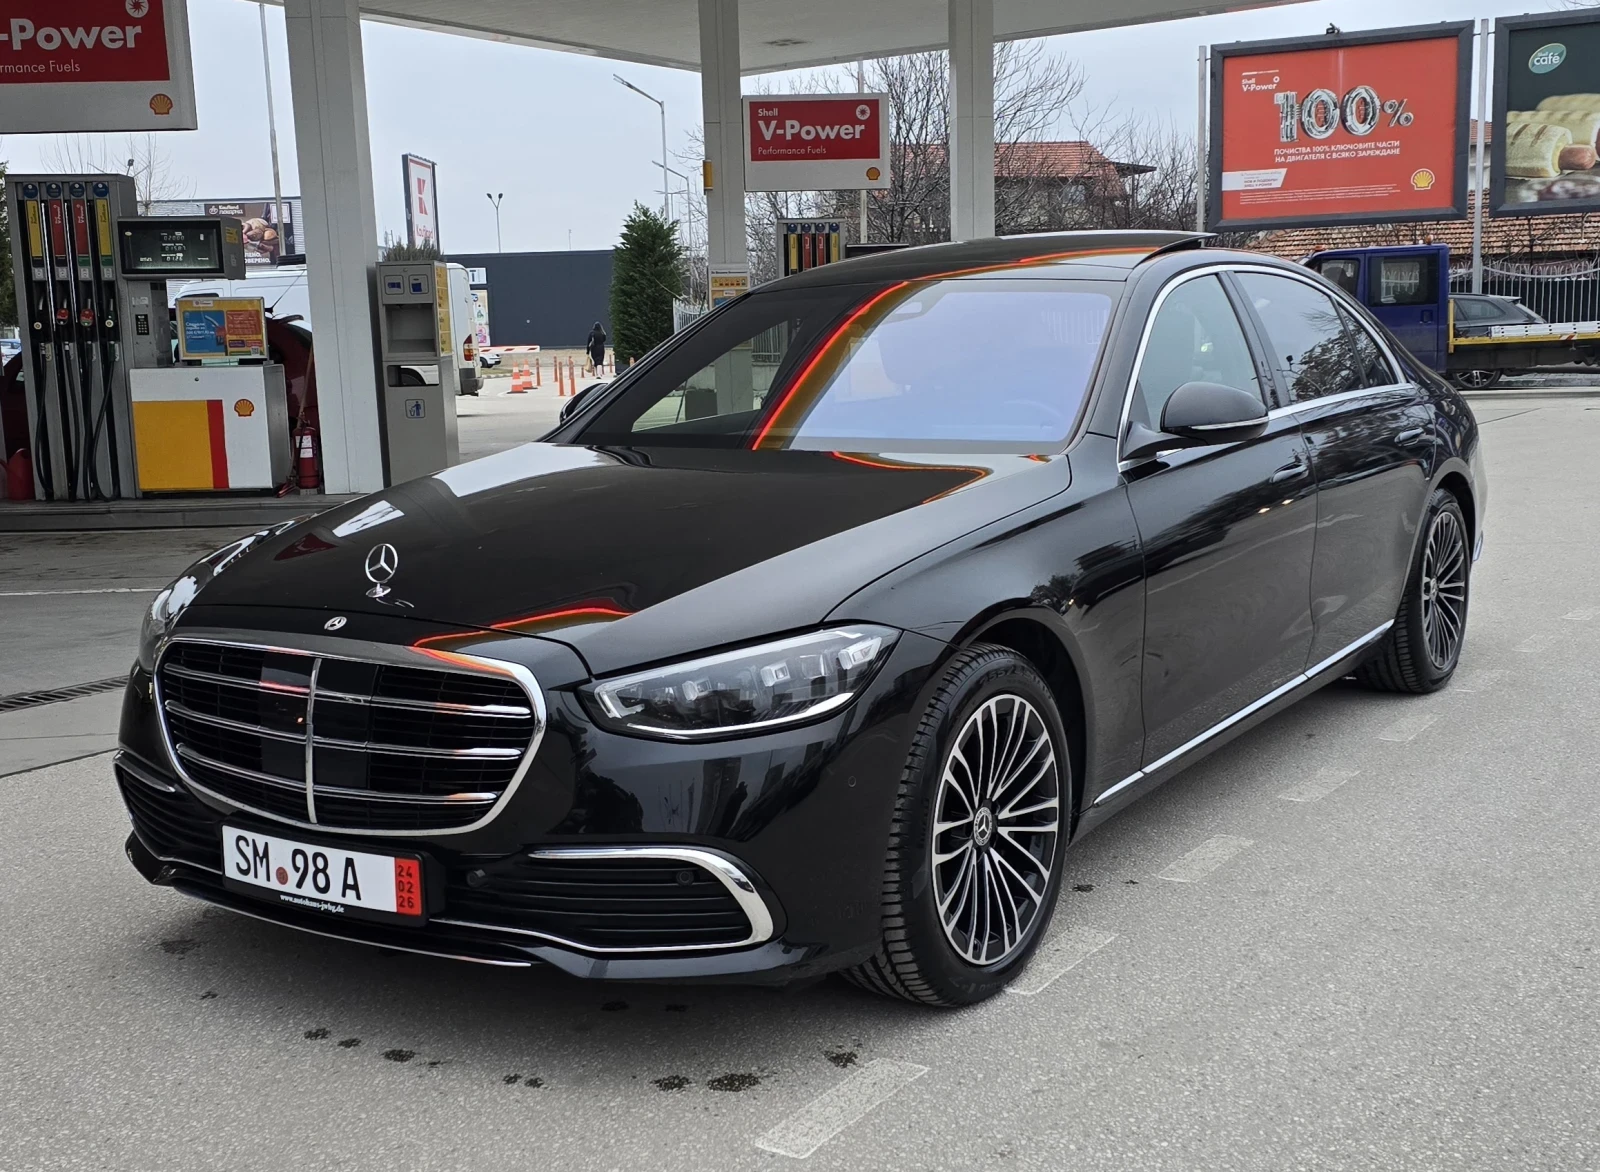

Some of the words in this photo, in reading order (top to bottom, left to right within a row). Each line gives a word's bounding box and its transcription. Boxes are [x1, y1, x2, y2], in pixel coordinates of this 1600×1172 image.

[1533, 52, 1560, 65] café
[49, 59, 81, 72] Fuels
[1242, 84, 1277, 92] V-Power
[757, 108, 779, 117] Shell
[758, 119, 865, 141] V-Power
[758, 146, 805, 155] Performance
[807, 146, 827, 154] Fuels
[1274, 146, 1311, 155] ПОЧИСТВА
[1312, 145, 1330, 153] 100%
[1331, 143, 1375, 151] КЛЮЧОВИТЕ
[1376, 140, 1400, 148] ЧАСТИ
[1286, 154, 1325, 163] ДВИГАТЕЛЯ
[1332, 151, 1356, 159] ВСЯКО
[1357, 148, 1400, 157] ЗАРЕЖДАНЕ
[235, 834, 271, 882] SM
[291, 848, 331, 895] 98
[341, 857, 362, 901] A
[397, 864, 413, 878] 24
[398, 880, 414, 893] 02
[398, 895, 415, 909] 26
